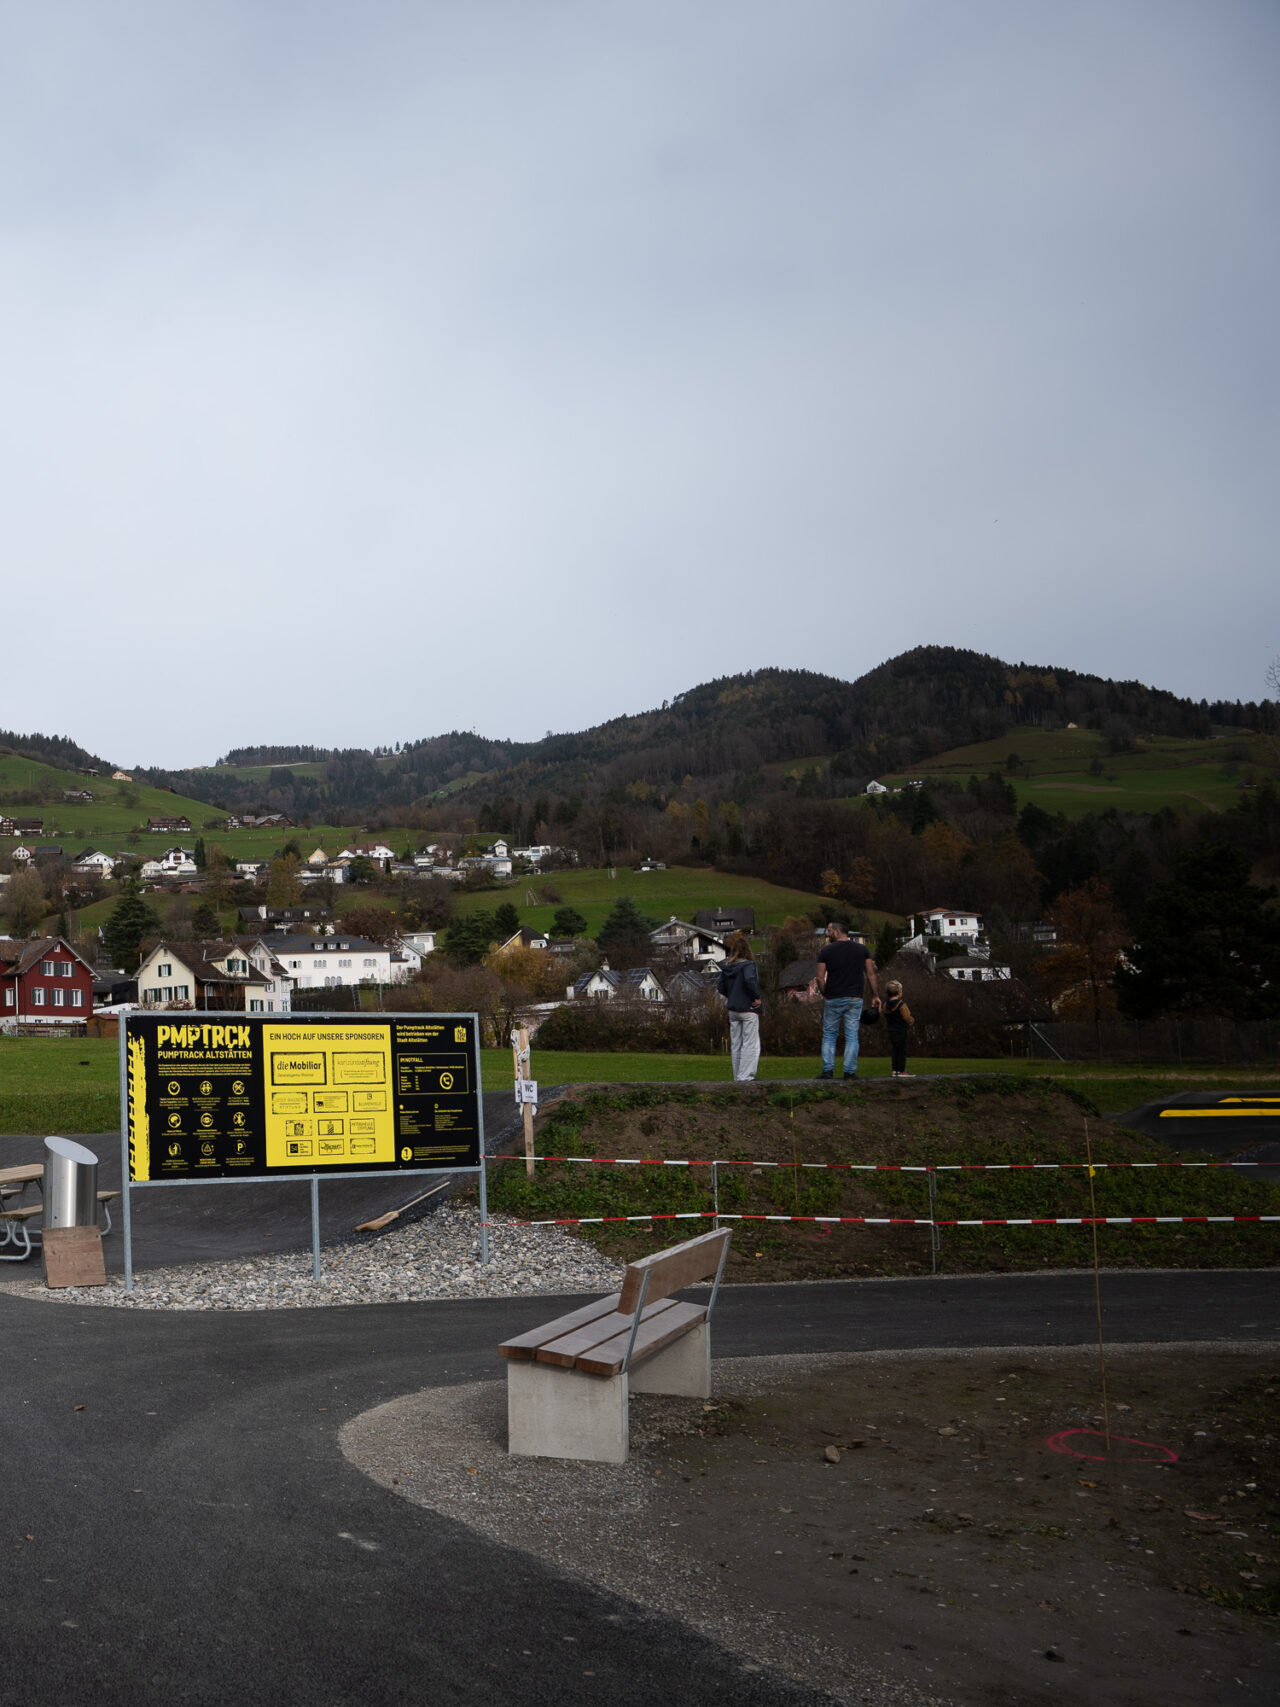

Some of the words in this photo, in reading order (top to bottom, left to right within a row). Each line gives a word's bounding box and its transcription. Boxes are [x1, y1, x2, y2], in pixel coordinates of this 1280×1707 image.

[157, 1024, 251, 1049] PMPTRCK
[270, 1033, 281, 1041] EIN
[282, 1033, 301, 1041] HOCH
[302, 1033, 316, 1041] AUF
[317, 1033, 344, 1041] UNSERE
[345, 1033, 385, 1041] SPONSOREN
[157, 1050, 204, 1059] PUMPTRACK
[206, 1049, 252, 1059] ALTSTÄTTEN
[277, 1061, 289, 1070] die
[289, 1060, 322, 1070] Mobiliar
[524, 1084, 533, 1093] WC
